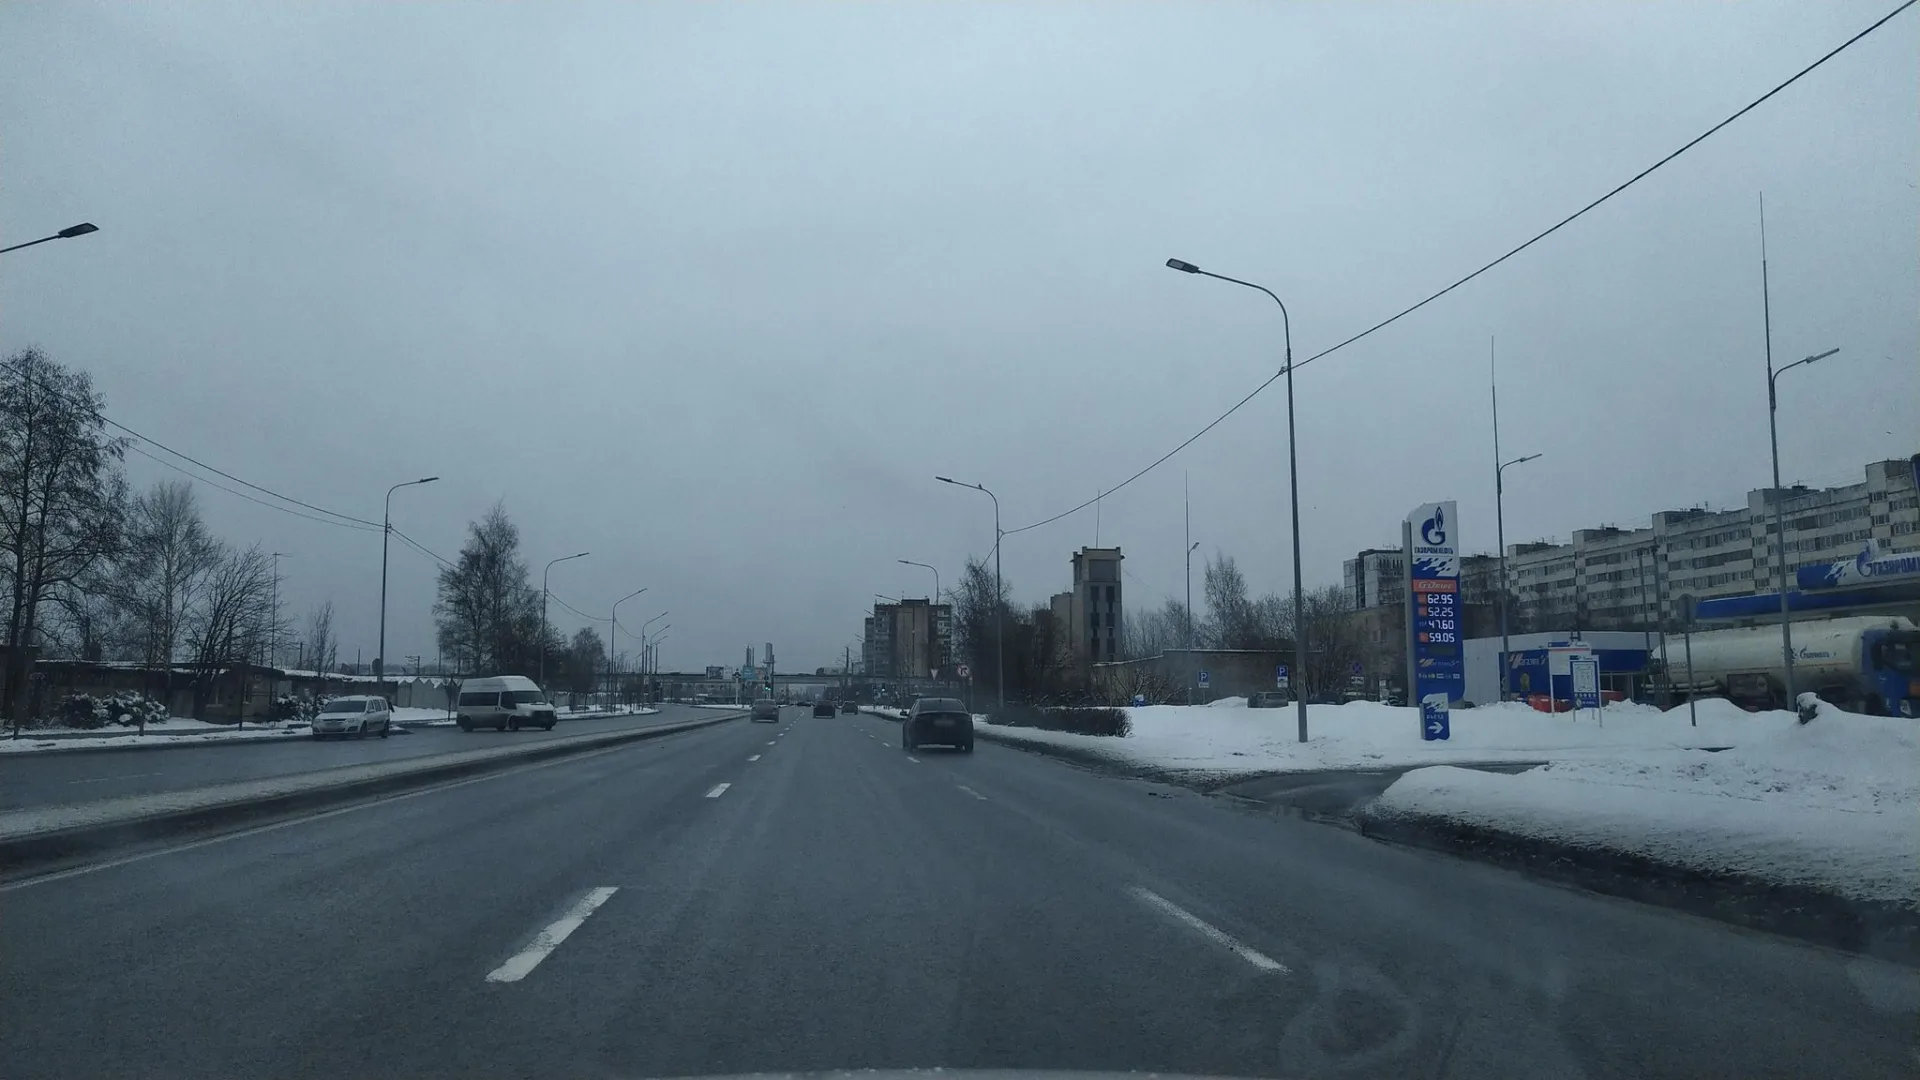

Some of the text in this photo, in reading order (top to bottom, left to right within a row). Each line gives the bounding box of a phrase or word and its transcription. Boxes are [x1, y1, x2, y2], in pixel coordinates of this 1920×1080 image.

[1427, 594, 1453, 604] 62.95
[1428, 607, 1454, 617] 52.25
[1428, 620, 1454, 630] 47.60
[1429, 632, 1455, 643] 59.05
